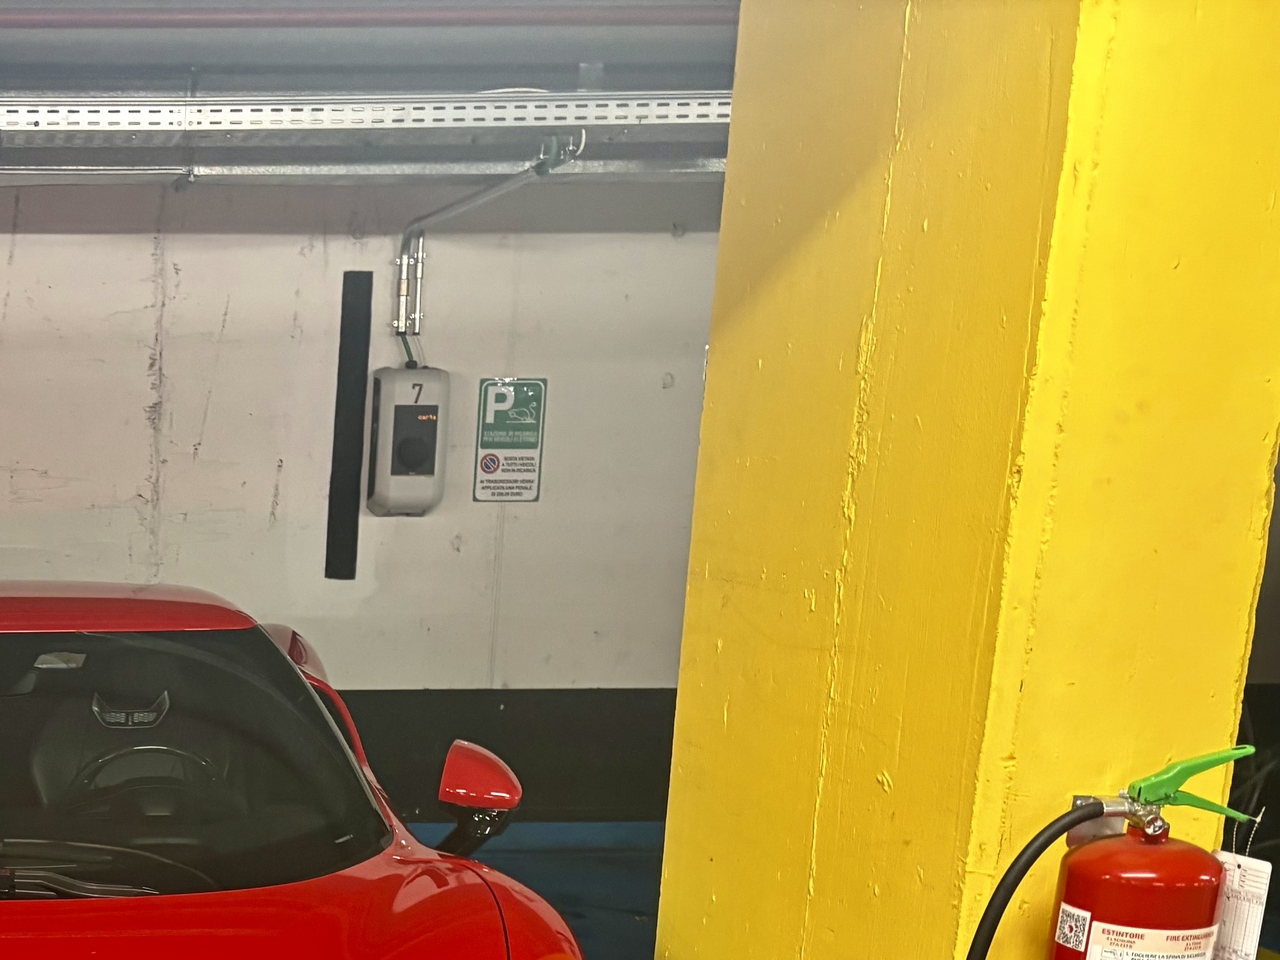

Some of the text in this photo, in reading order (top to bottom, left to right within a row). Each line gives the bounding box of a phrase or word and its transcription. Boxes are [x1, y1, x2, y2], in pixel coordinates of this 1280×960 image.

[412, 383, 423, 404] 7
[485, 386, 515, 424] P
[1102, 928, 1145, 940] ESTINTORE
